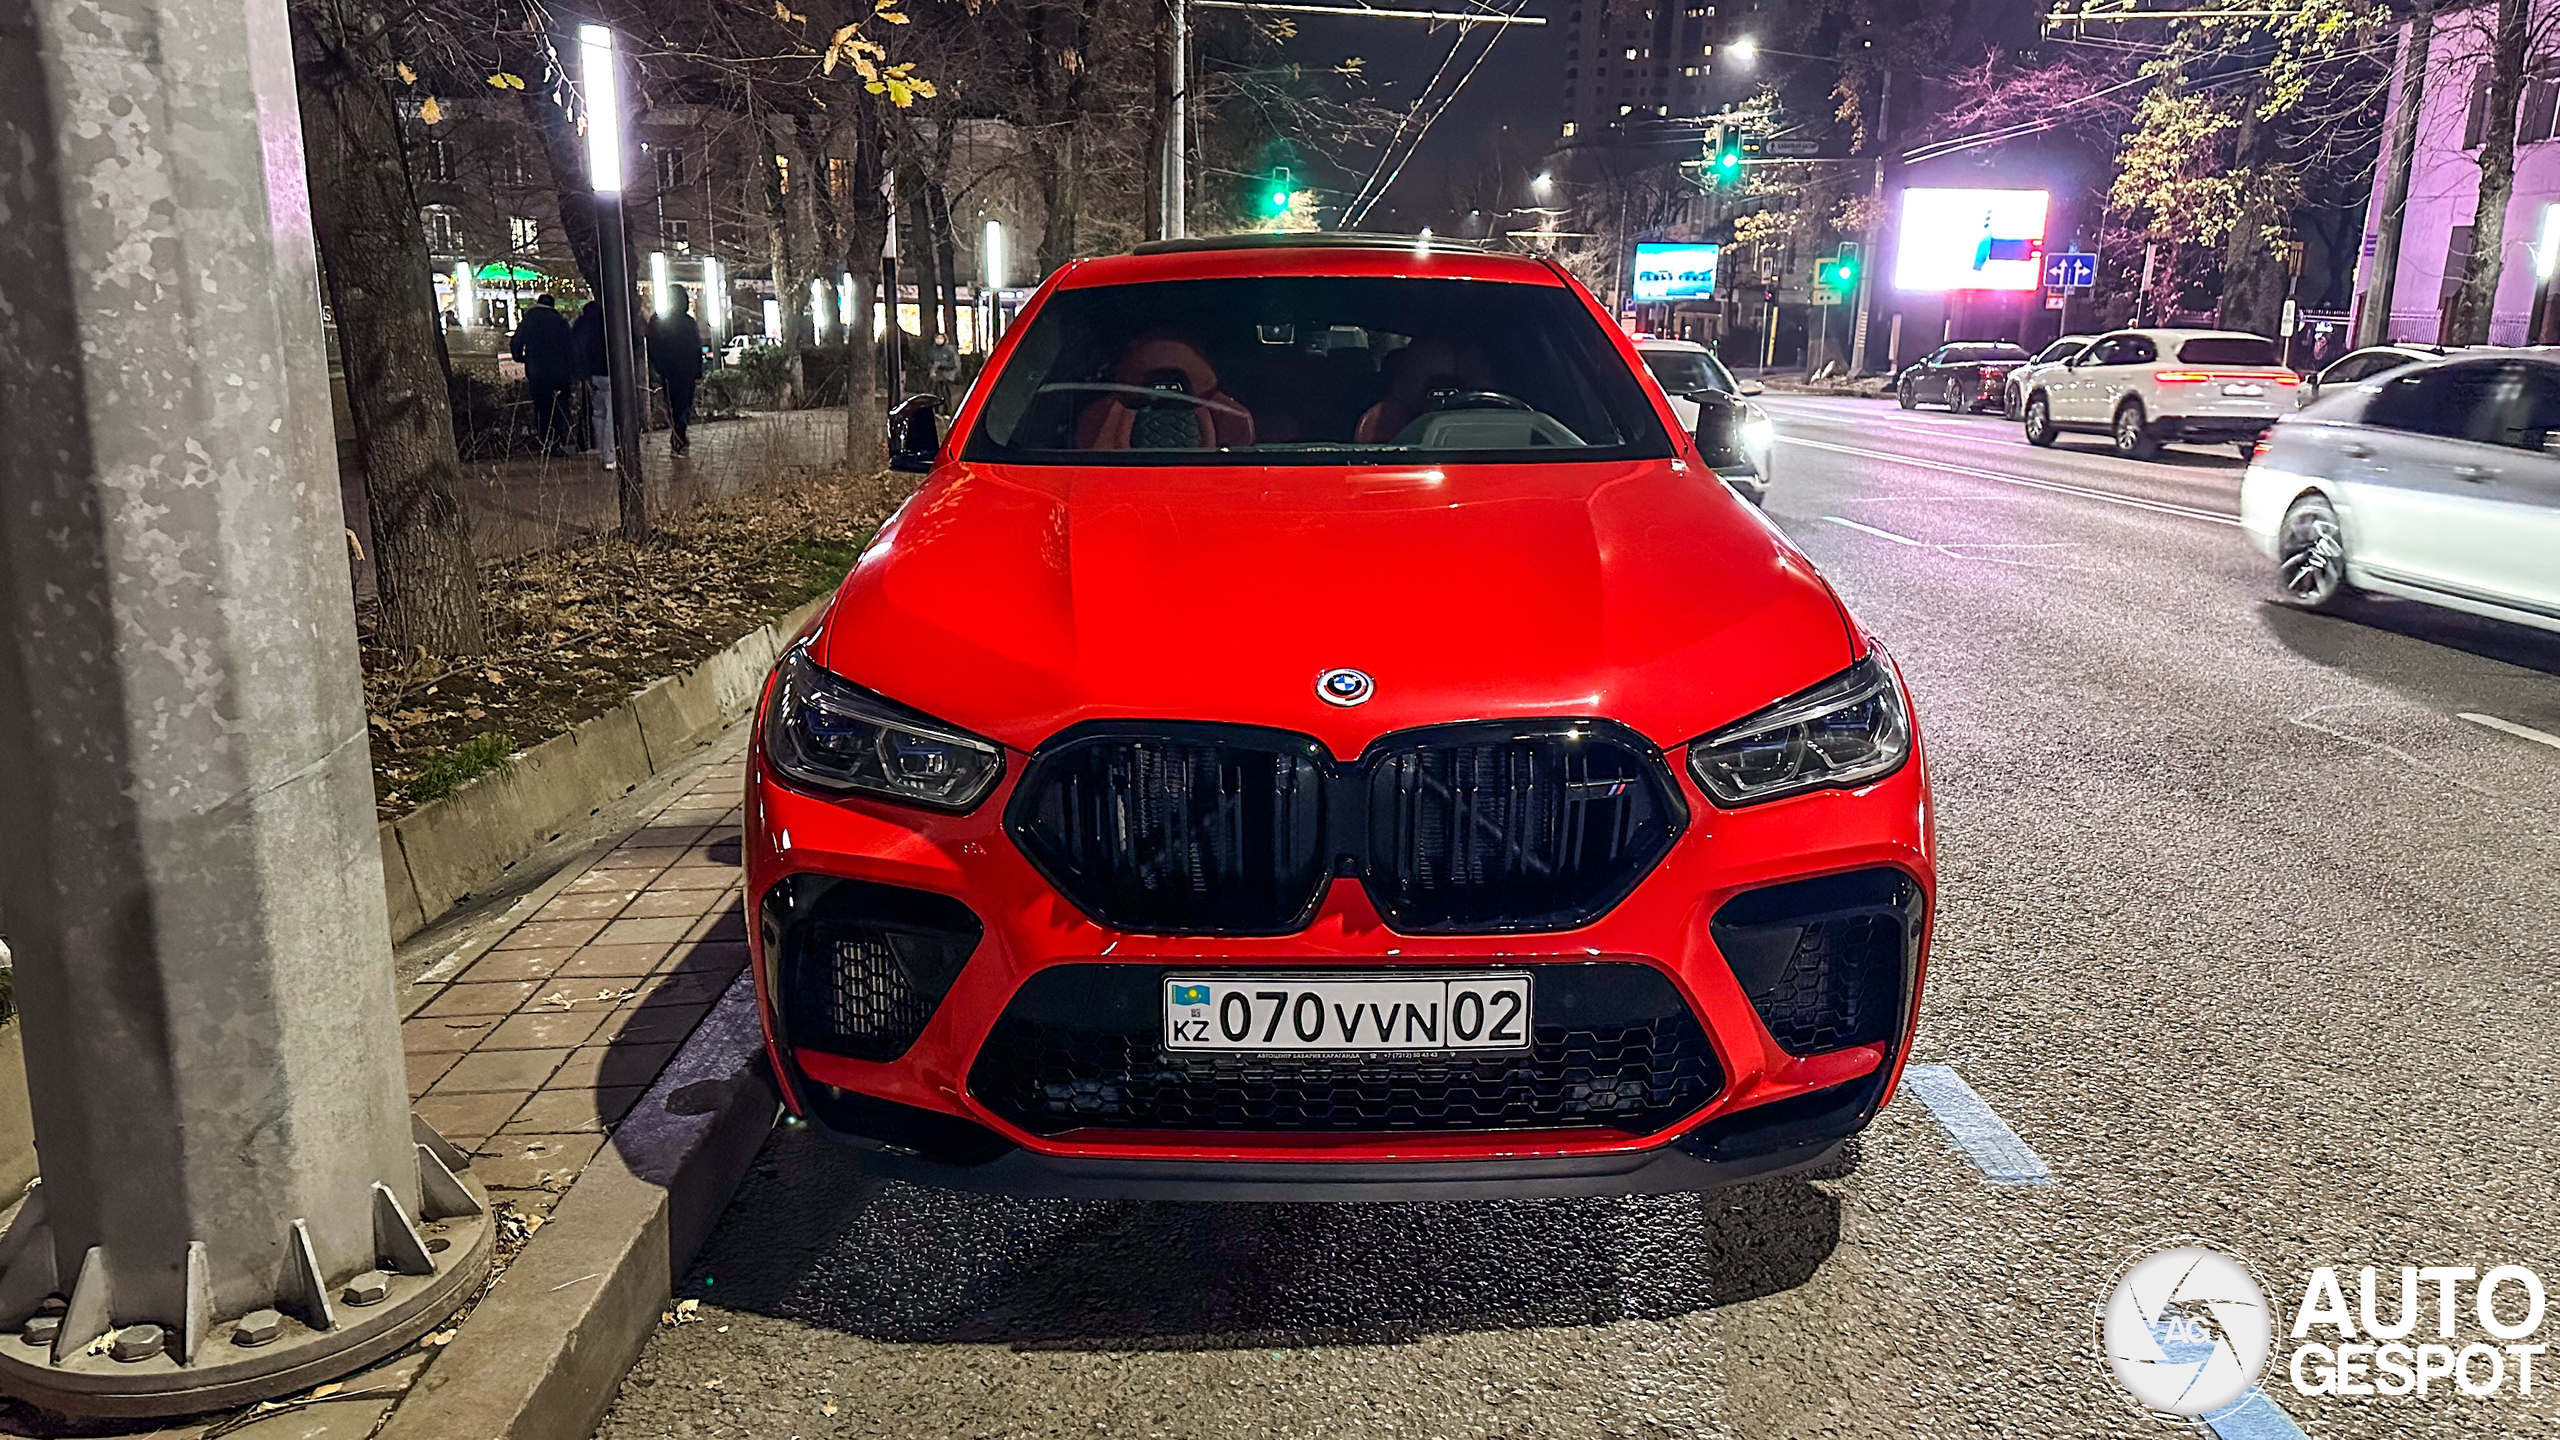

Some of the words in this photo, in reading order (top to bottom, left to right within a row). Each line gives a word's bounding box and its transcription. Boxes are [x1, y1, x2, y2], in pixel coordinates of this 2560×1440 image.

[1174, 1020, 1210, 1042] KZ
[1219, 991, 1325, 1043] 070
[1334, 1002, 1438, 1043] VVN
[1454, 990, 1522, 1042] 02
